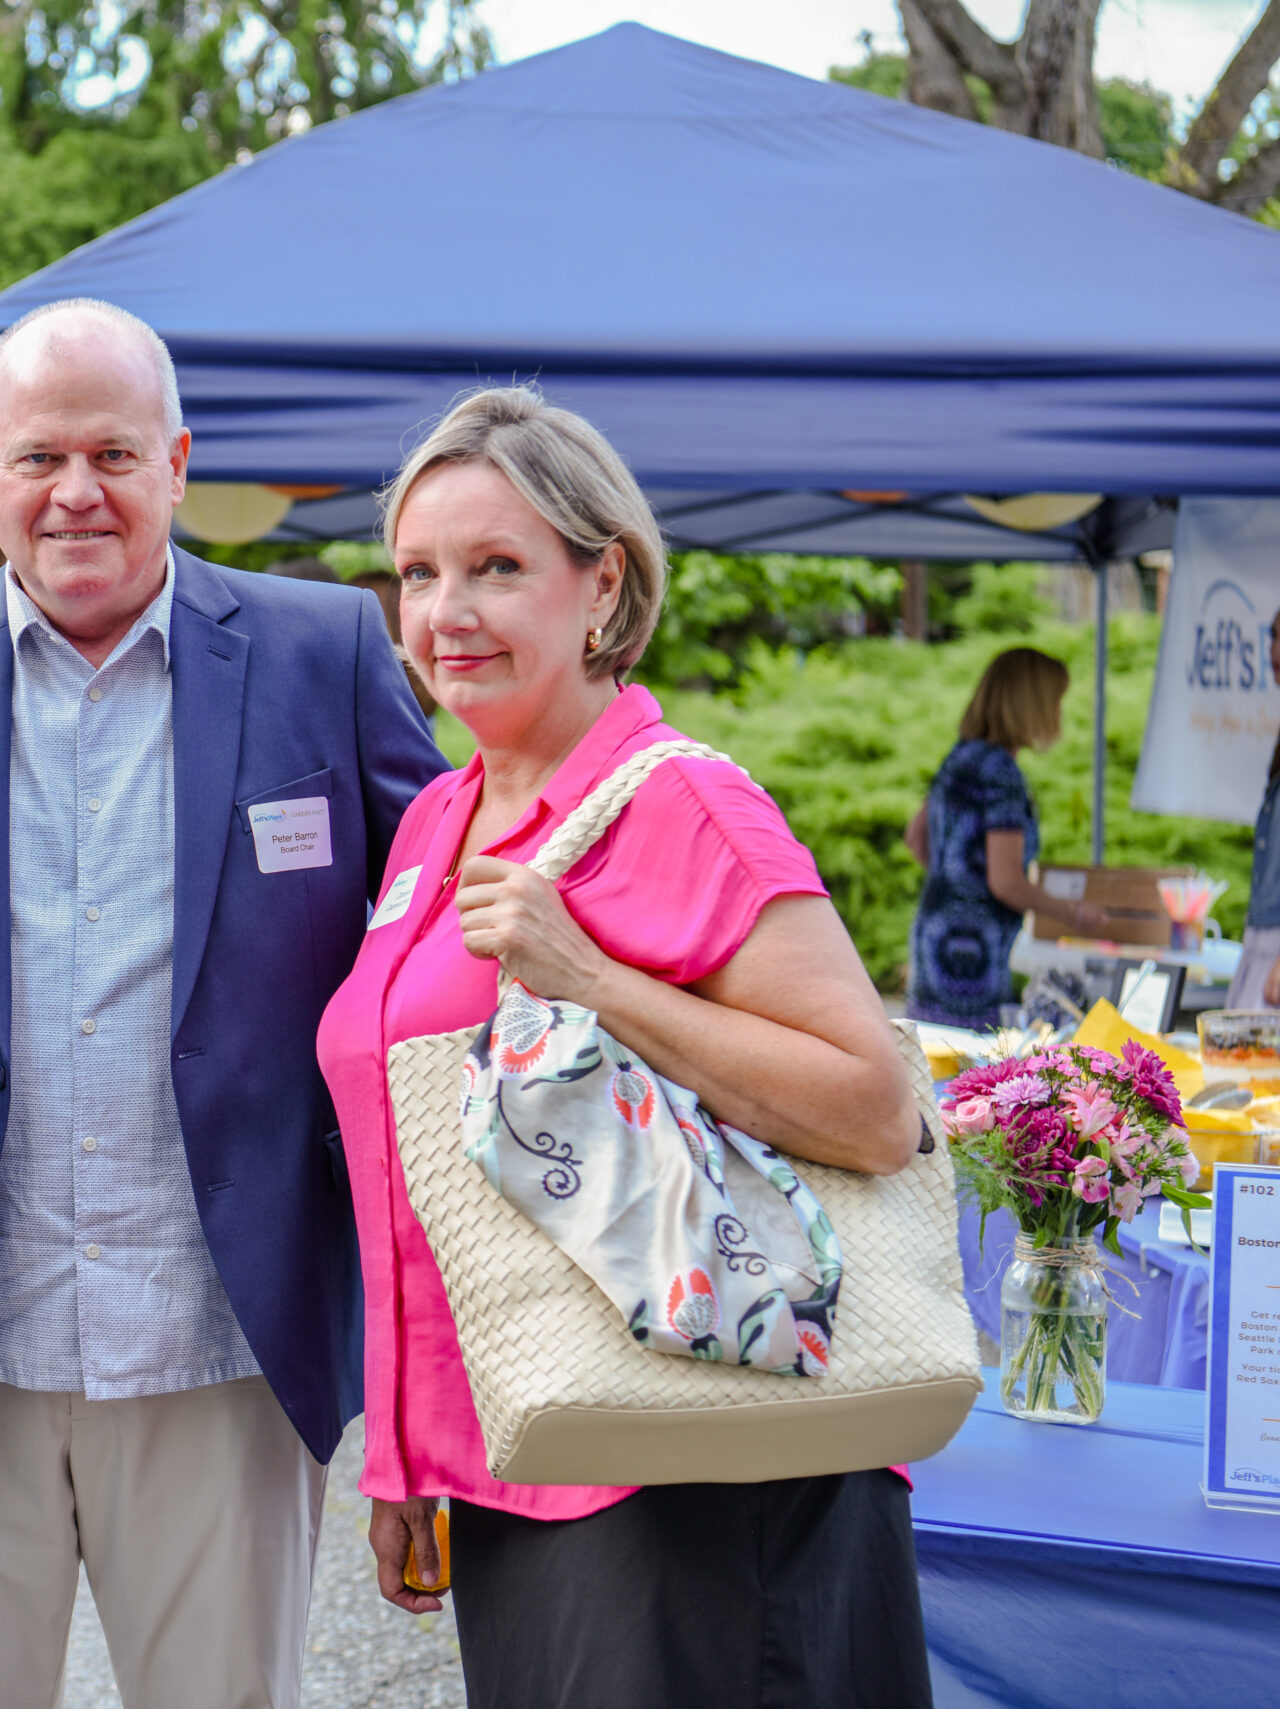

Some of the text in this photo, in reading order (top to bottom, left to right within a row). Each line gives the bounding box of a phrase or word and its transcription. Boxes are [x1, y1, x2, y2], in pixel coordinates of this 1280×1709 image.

[272, 832, 318, 844] Peter Barron
[280, 843, 314, 853] Board Chair
[1239, 1184, 1275, 1196] #102
[1251, 1311, 1270, 1319] Get
[1241, 1322, 1278, 1331] Boston
[1238, 1333, 1275, 1343] Seattle
[1251, 1346, 1274, 1354] Park
[1242, 1363, 1266, 1372] Your
[1236, 1374, 1279, 1385] Red Sox
